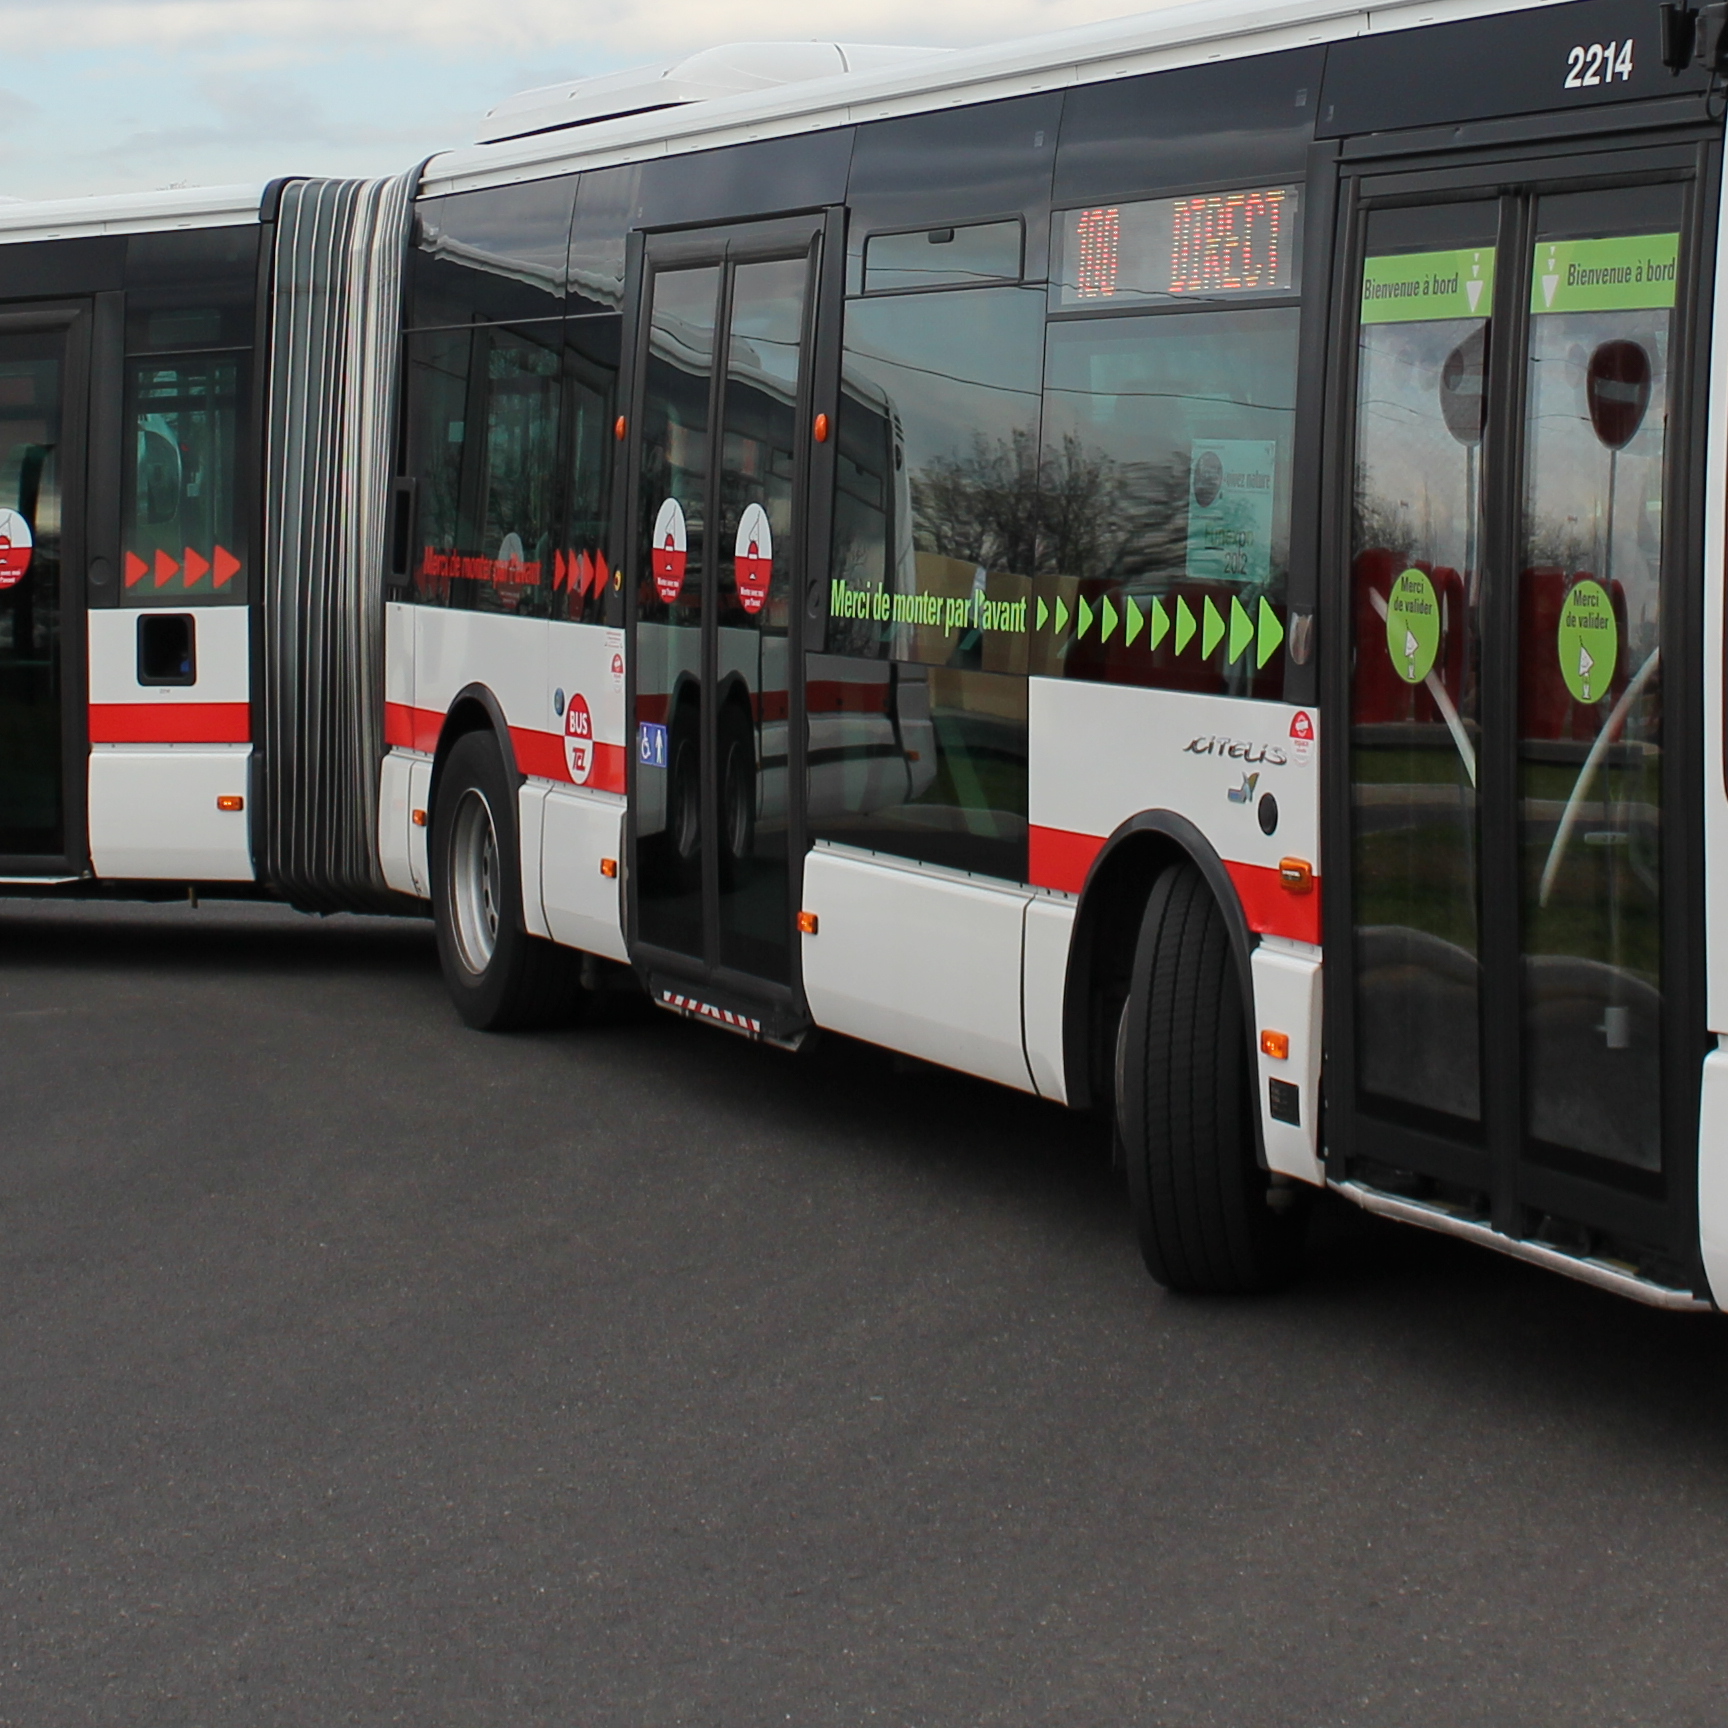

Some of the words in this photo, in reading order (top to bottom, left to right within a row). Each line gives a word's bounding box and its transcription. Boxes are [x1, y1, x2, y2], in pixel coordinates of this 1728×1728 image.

[1564, 38, 1634, 89] 2214
[1076, 208, 1119, 298] 100
[1168, 190, 1286, 292] DIRECT
[1566, 262, 1632, 286] Bienvenue
[1635, 260, 1643, 283] à
[1646, 257, 1676, 281] bord
[1363, 277, 1420, 300] Bienvenue
[1422, 275, 1430, 297] à
[1432, 272, 1459, 295] bord
[1400, 576, 1424, 594] Merci
[1573, 589, 1599, 608] Merci
[830, 579, 871, 620] Merci
[873, 581, 891, 622] de
[892, 589, 944, 626] monter
[944, 596, 972, 638] par
[973, 588, 1027, 634] l'avant
[1393, 597, 1404, 612] de
[1405, 598, 1433, 616] valider
[1566, 612, 1577, 628] de
[1578, 614, 1609, 630] valider
[569, 710, 589, 736] BUS
